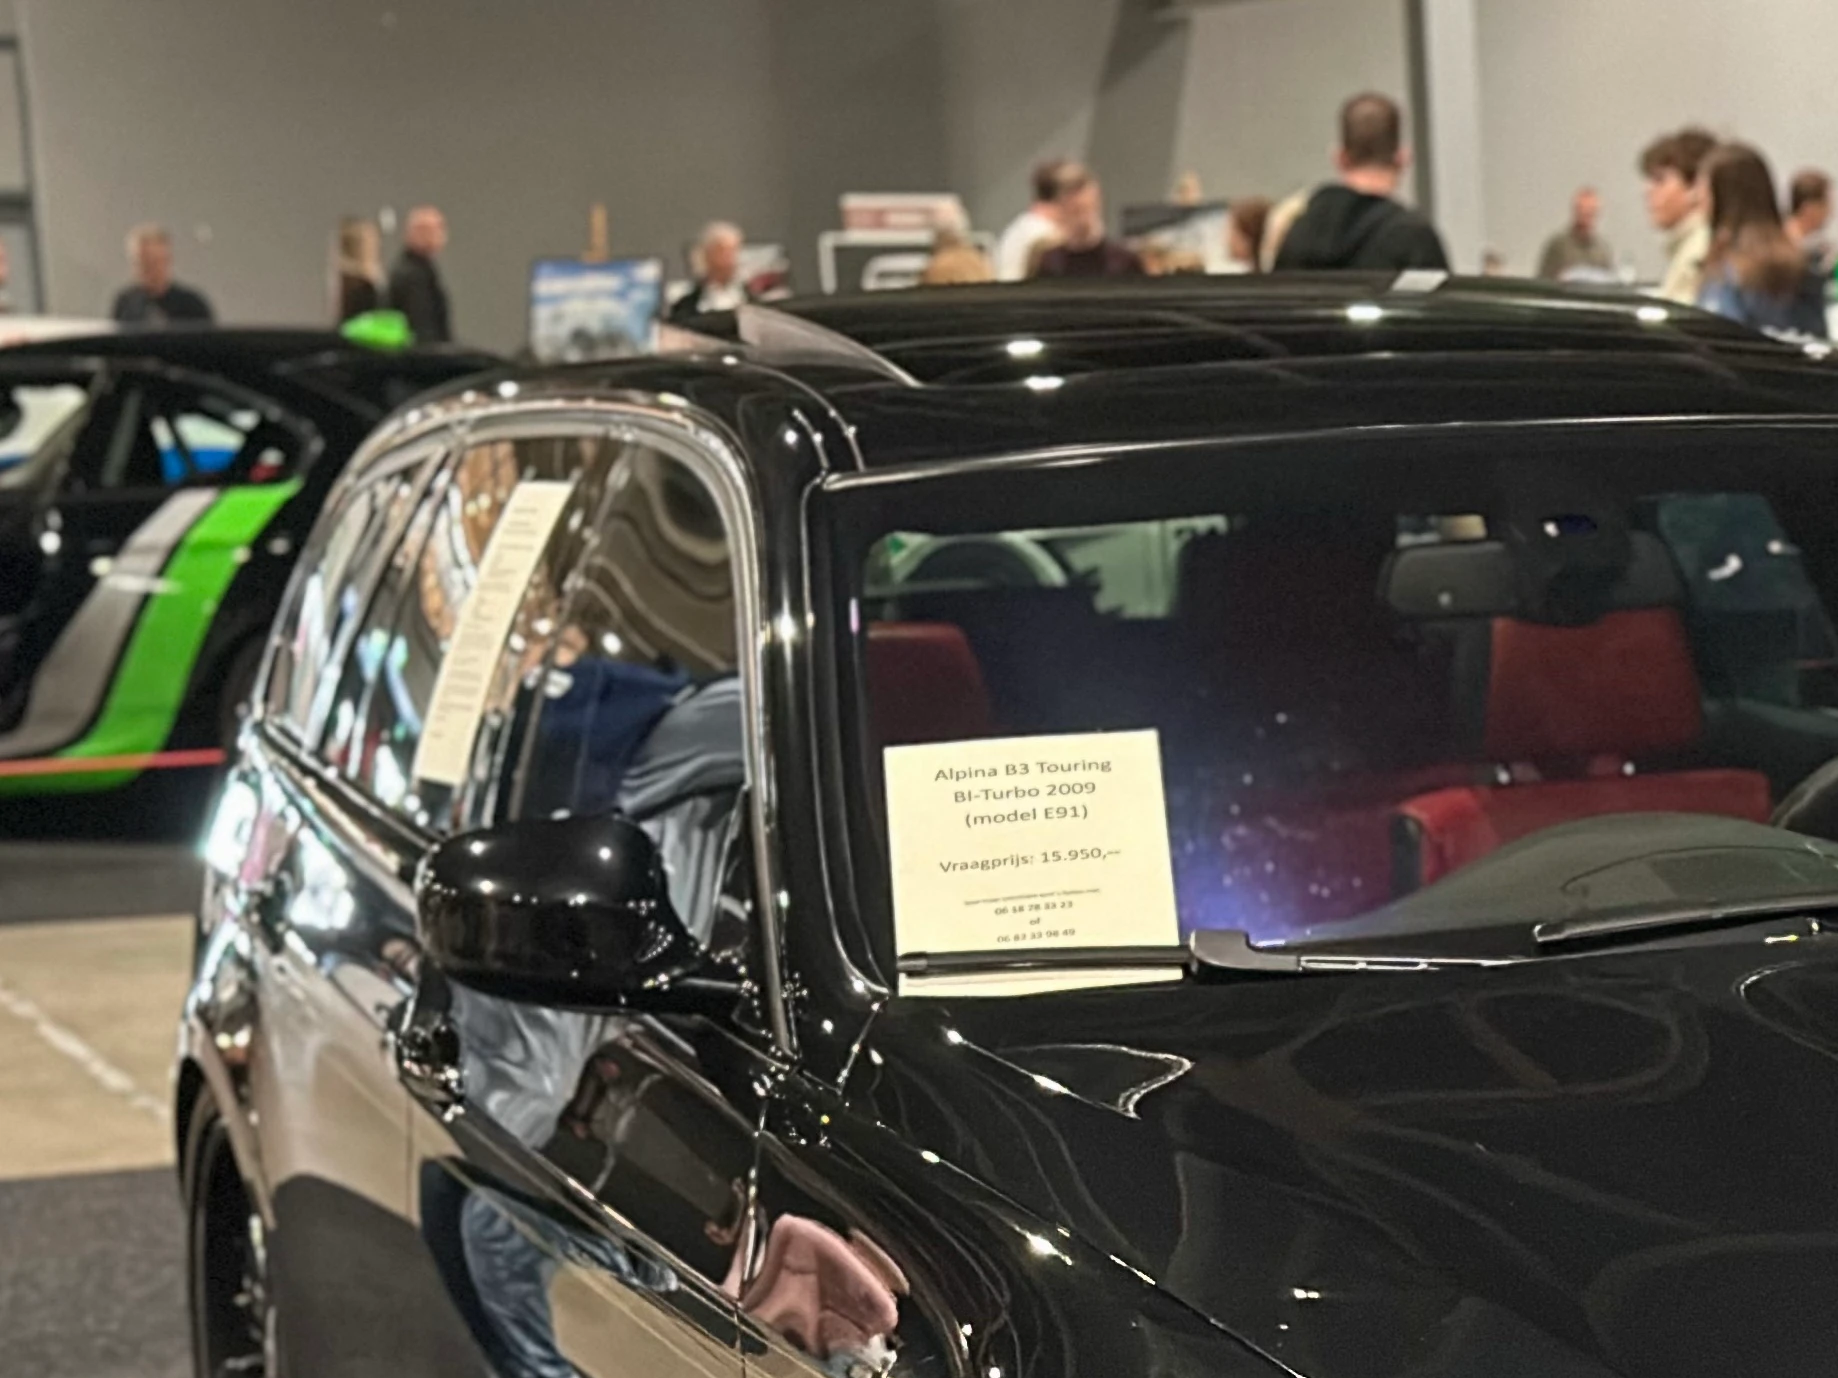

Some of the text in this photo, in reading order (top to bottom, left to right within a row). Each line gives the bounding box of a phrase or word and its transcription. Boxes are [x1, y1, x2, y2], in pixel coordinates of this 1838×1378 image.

[934, 759, 1112, 782] Alpina B3 Touring
[1046, 782, 1096, 796] 2009
[965, 805, 1089, 827] (model E91)
[939, 854, 1034, 873] Vraagprijs:
[994, 907, 1008, 915] 06
